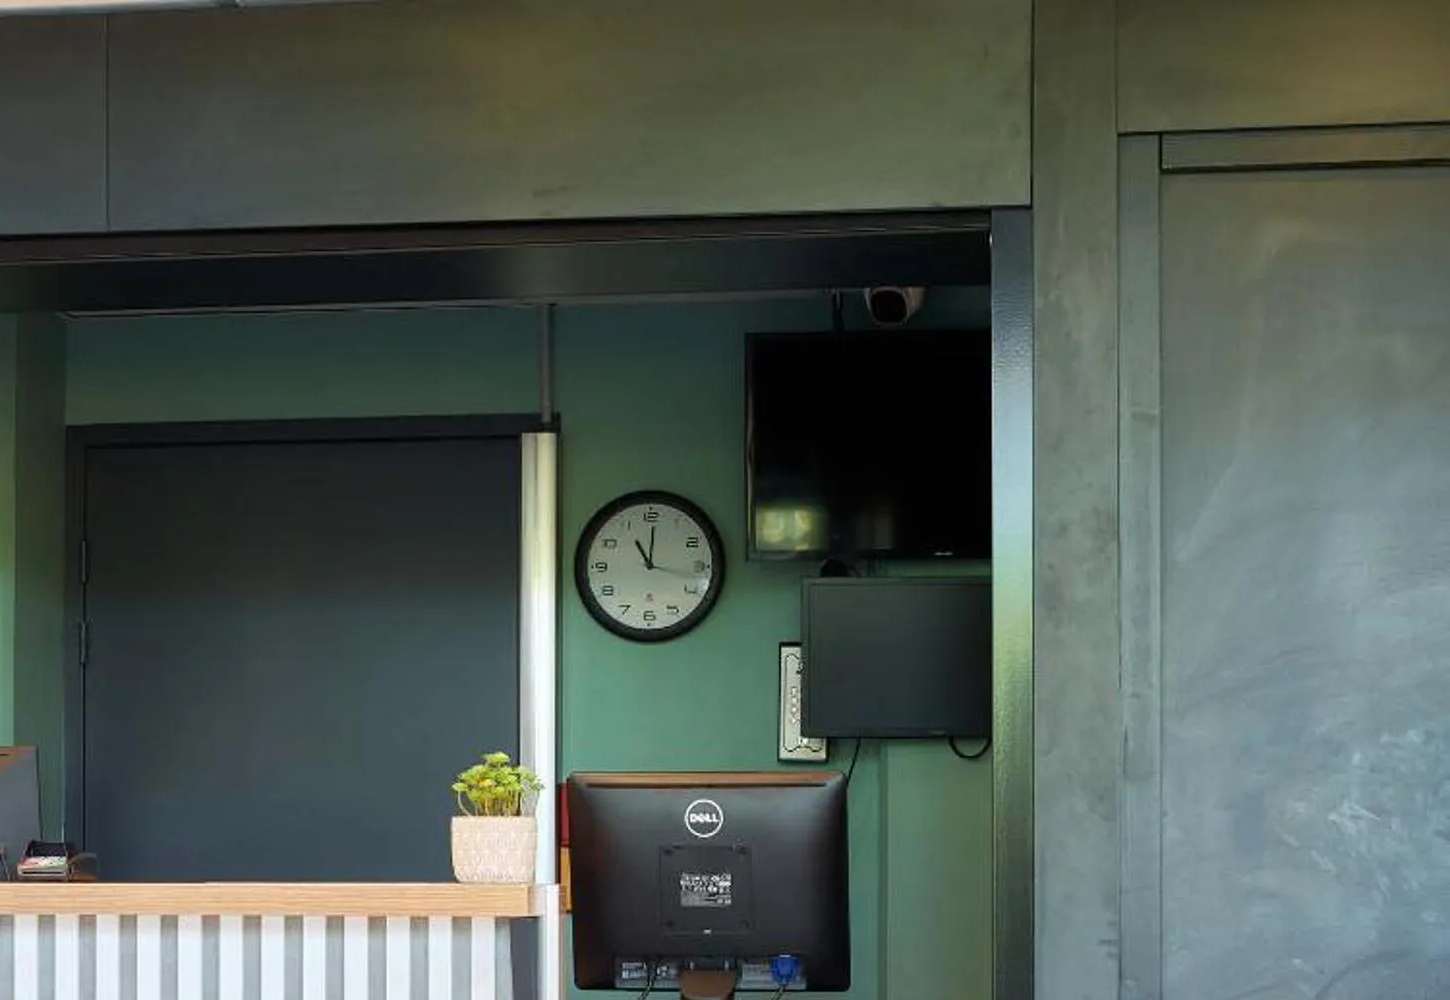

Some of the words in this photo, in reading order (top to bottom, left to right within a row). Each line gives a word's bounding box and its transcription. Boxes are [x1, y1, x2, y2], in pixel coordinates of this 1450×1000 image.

[685, 536, 699, 548] 2
[594, 561, 608, 573] 9
[601, 585, 614, 596] 8
[617, 603, 631, 616] 7
[643, 610, 656, 621] 6
[689, 812, 720, 823] DELL
